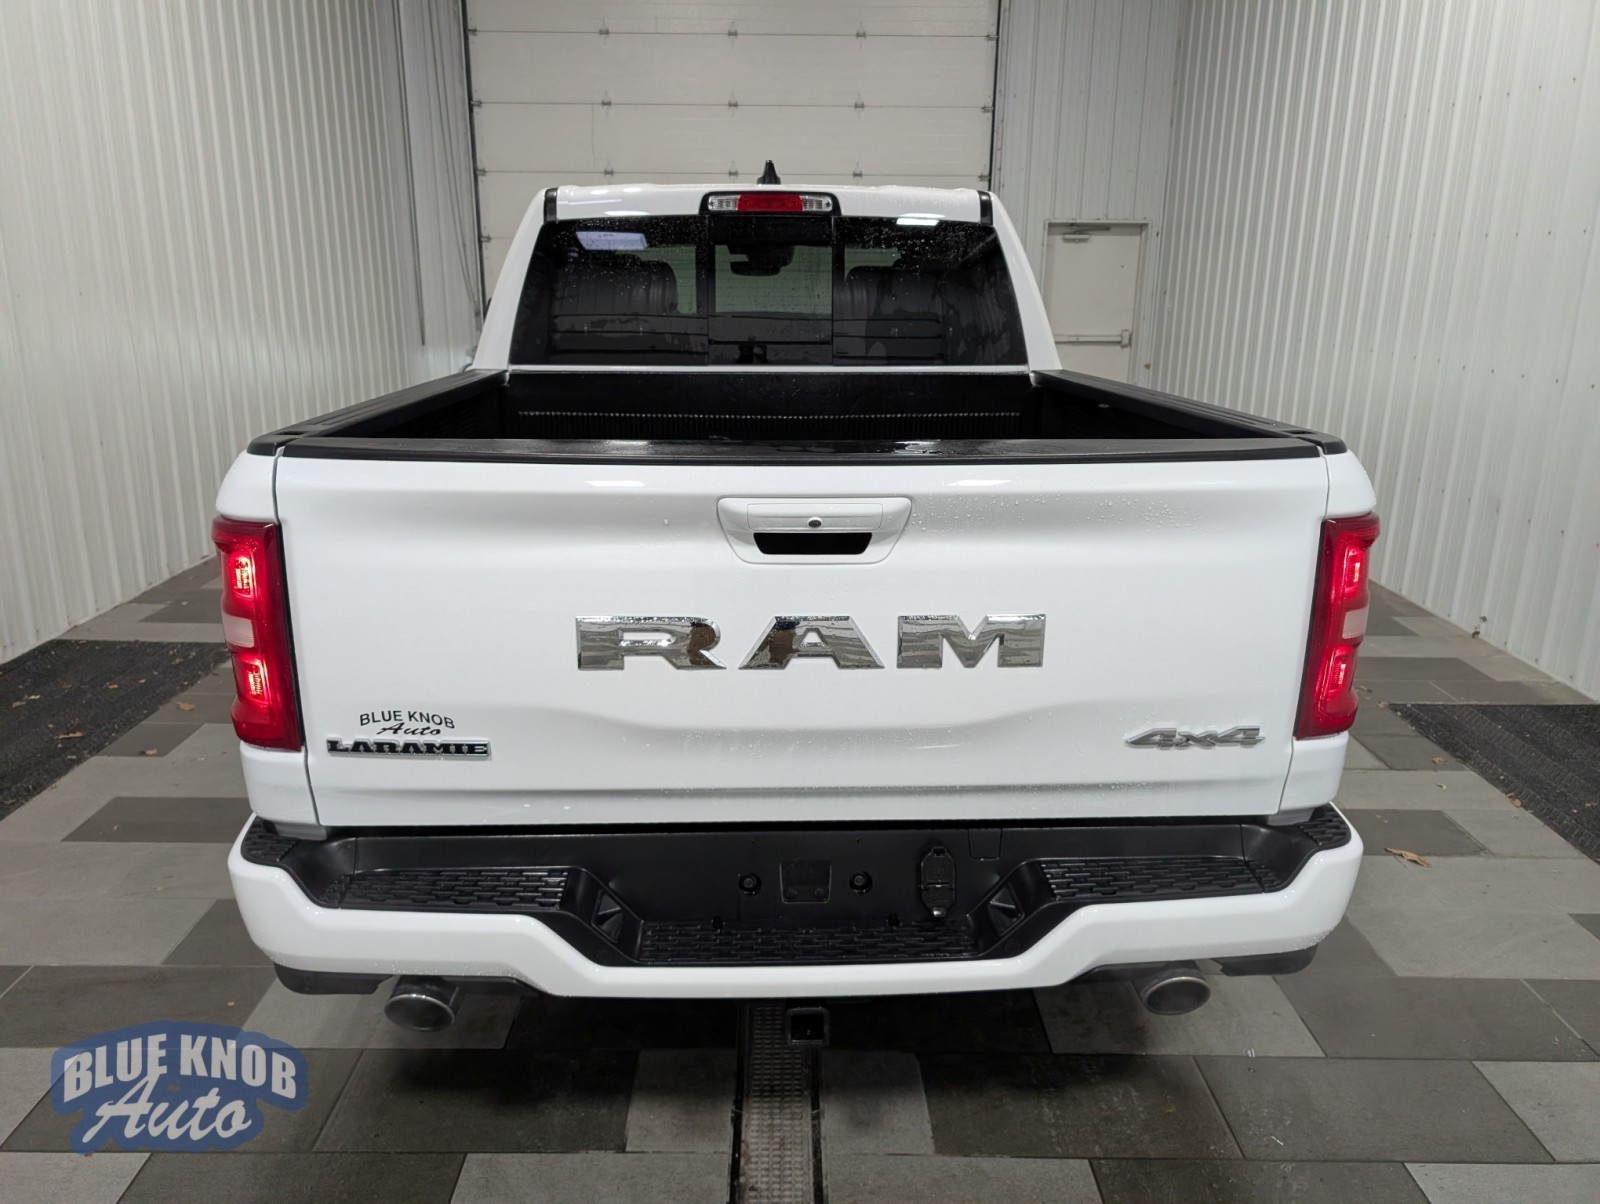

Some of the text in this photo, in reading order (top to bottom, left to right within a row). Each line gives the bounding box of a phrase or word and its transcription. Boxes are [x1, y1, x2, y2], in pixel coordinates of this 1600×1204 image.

[575, 613, 1047, 671] RAM
[359, 710, 455, 729] BLUE KNOB
[376, 722, 441, 736] Auto
[1125, 726, 1265, 749] 4x4
[326, 738, 491, 757] LARAMIE
